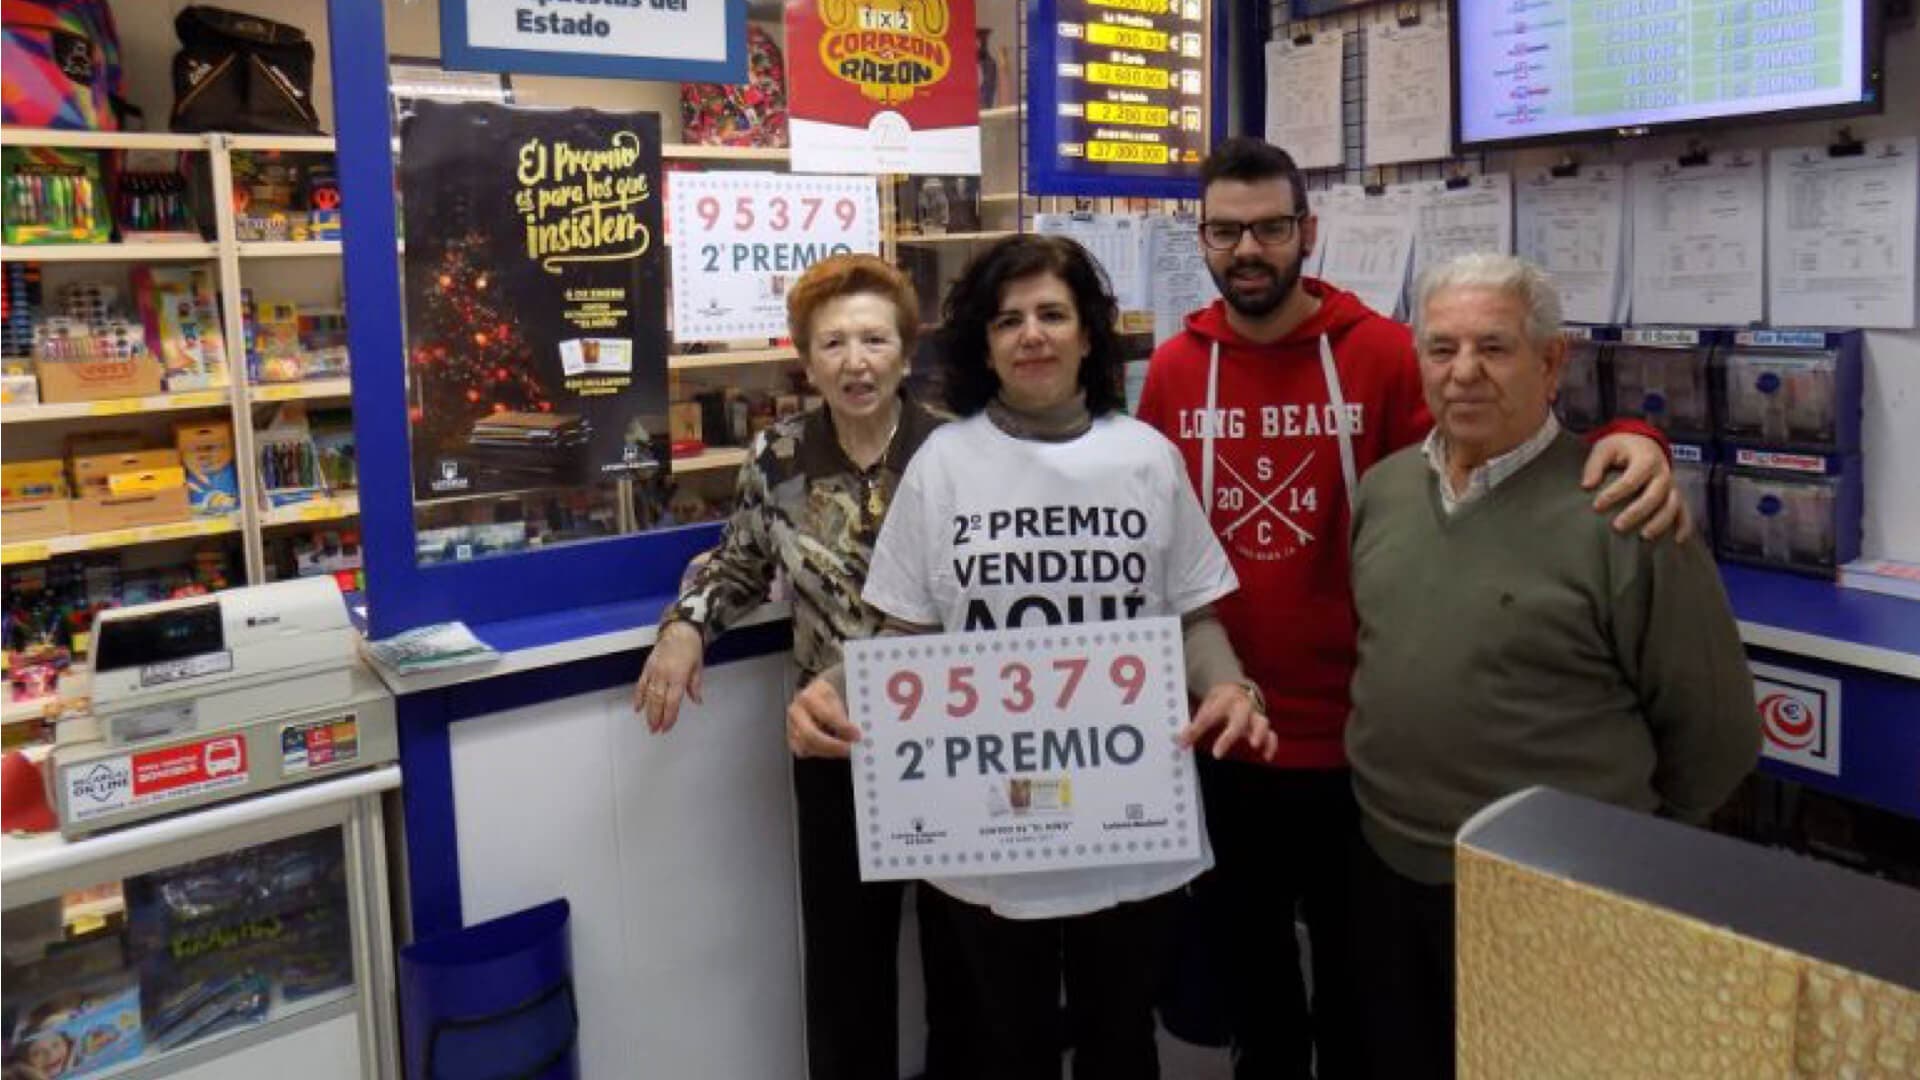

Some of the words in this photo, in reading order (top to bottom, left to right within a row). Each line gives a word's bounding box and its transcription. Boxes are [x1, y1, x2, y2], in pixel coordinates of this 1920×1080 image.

[515, 8, 611, 38] Estado
[553, 136, 640, 182] Premio
[515, 187, 536, 214] es
[538, 184, 583, 220] para
[585, 171, 613, 200] los
[615, 172, 649, 212] que
[696, 195, 858, 232] 95379
[526, 201, 641, 260] insisten
[1178, 408, 1246, 439] LONG
[1256, 456, 1274, 481] S
[1216, 487, 1244, 511] 20
[1289, 487, 1317, 512] 14
[988, 505, 1148, 541] PREMIO
[1256, 520, 1272, 546] C
[952, 549, 1147, 589] VENDIDO
[885, 653, 1148, 722] 95379
[944, 723, 1145, 778] PREMIO
